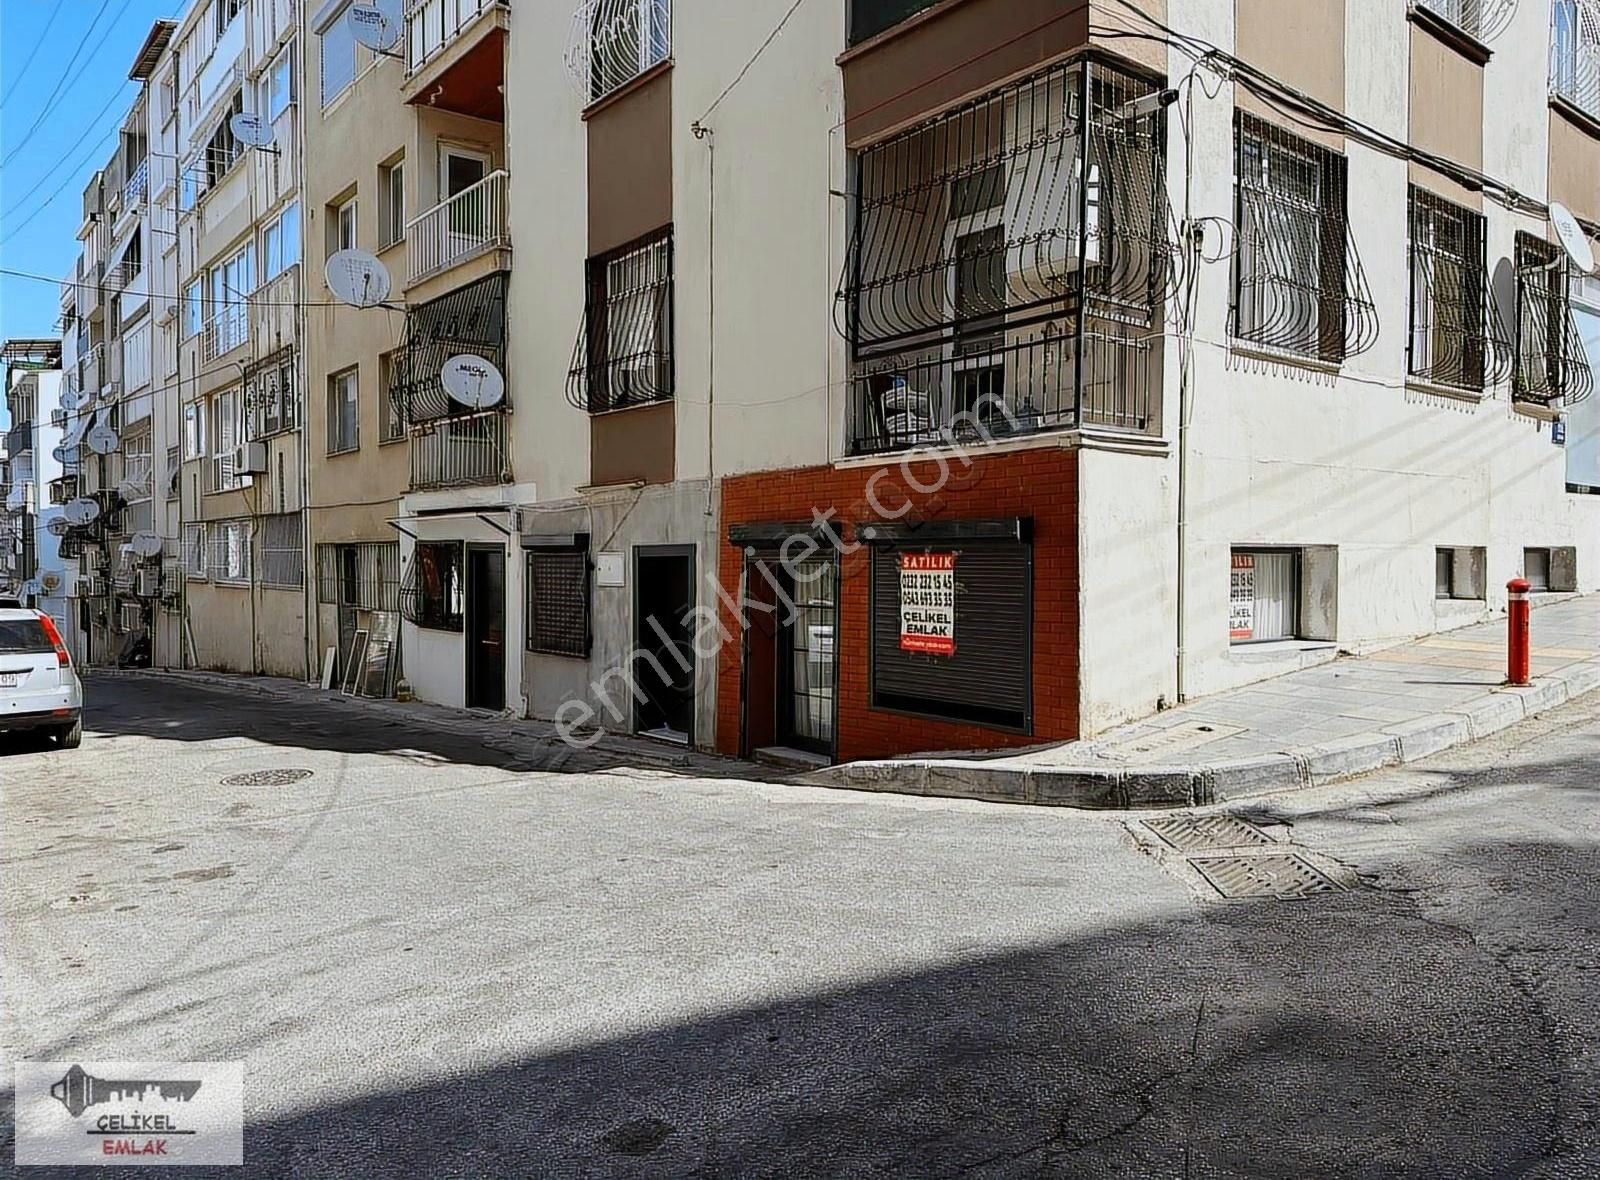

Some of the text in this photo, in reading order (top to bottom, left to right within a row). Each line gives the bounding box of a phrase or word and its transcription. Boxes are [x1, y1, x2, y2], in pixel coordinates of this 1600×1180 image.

[903, 556, 952, 568] SATILIK
[902, 574, 918, 589] 0232
[920, 574, 932, 589] 232
[943, 574, 953, 590] 45
[903, 609, 952, 624] ÇELİKEL
[907, 624, 947, 636] EMLAK
